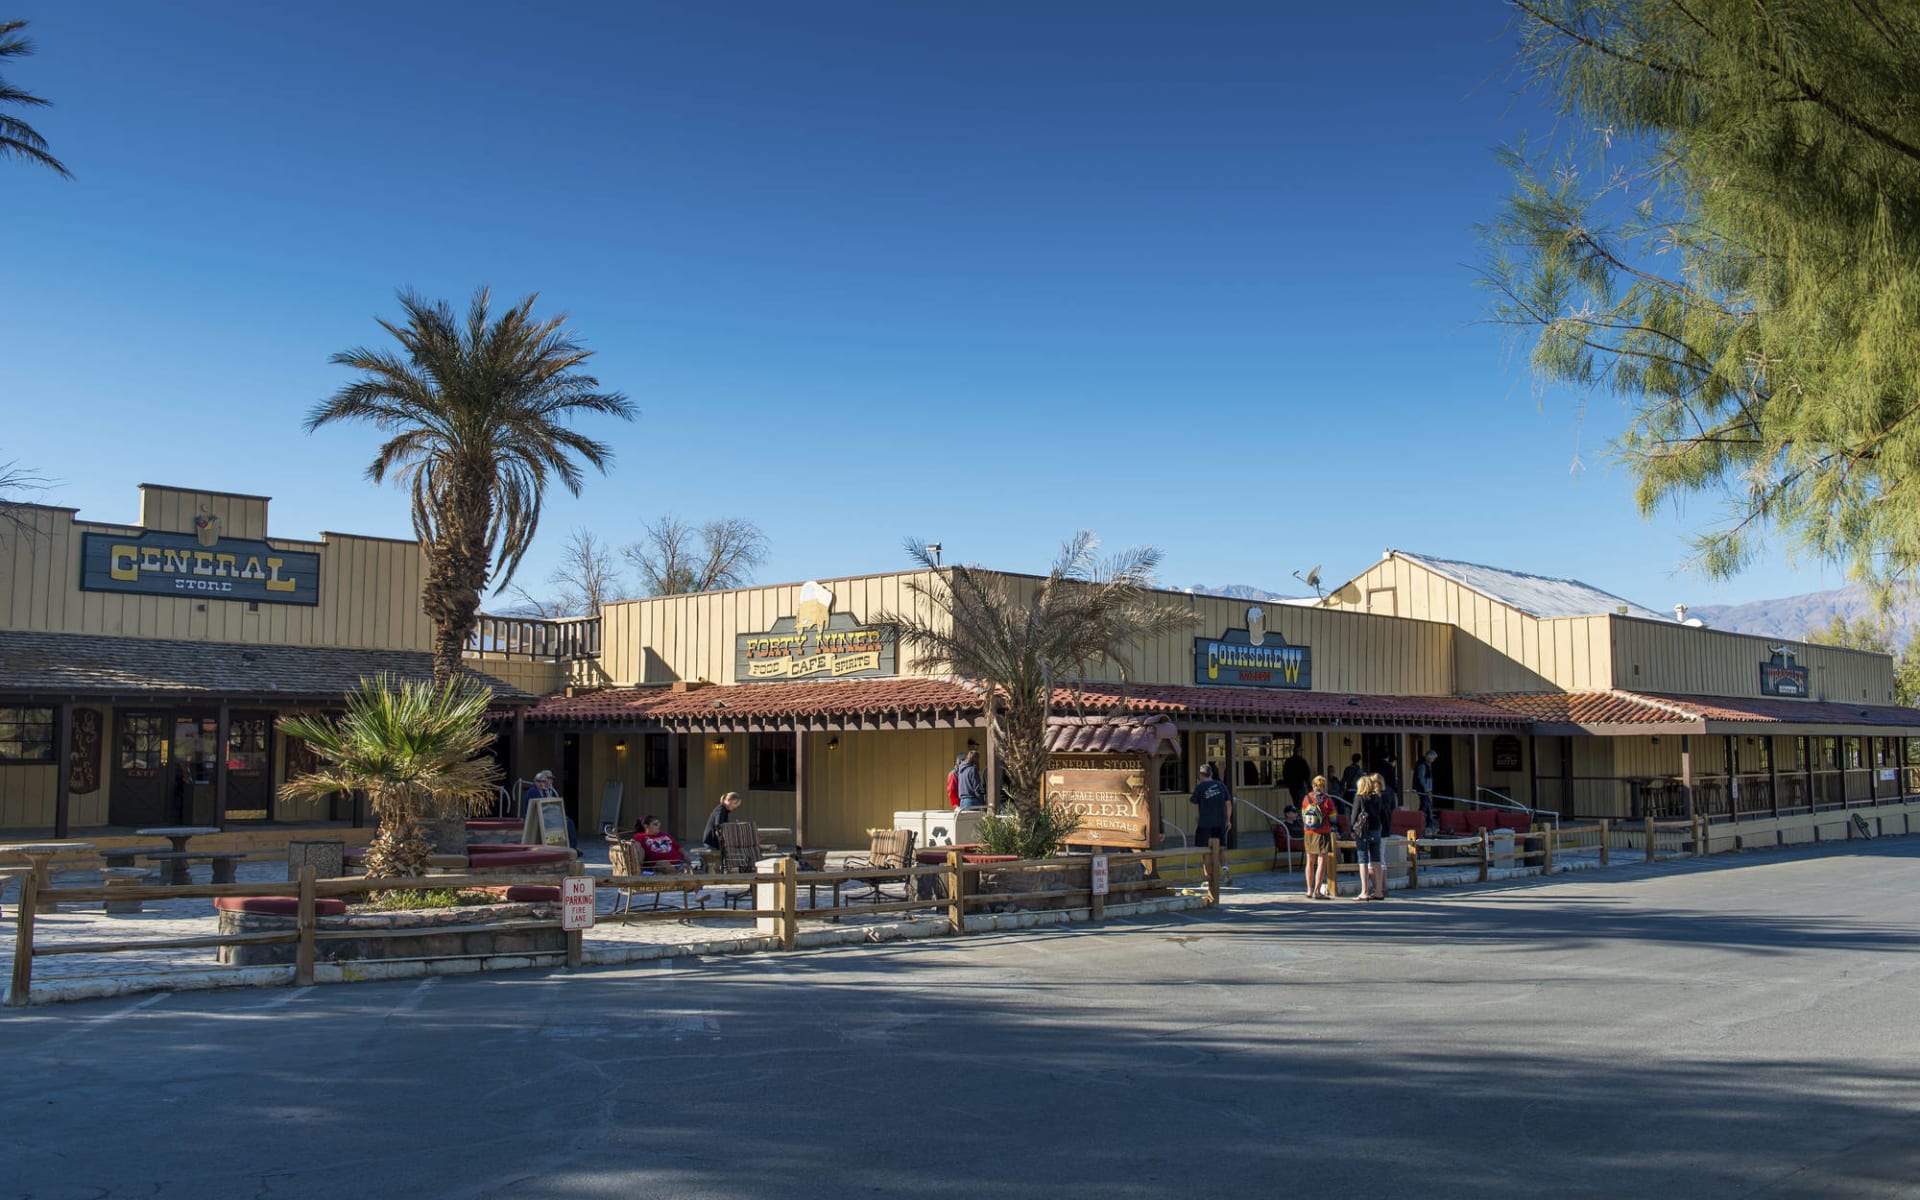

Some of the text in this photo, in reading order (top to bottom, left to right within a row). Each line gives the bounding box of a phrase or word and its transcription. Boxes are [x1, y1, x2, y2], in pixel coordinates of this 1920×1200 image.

[111, 545, 296, 592] GENERAL
[175, 579, 232, 591] STORE
[746, 630, 883, 657] FORTY NINER
[753, 662, 780, 674] FOOD
[791, 656, 826, 675] CAFE
[835, 655, 871, 672] SPIRITS
[1208, 642, 1302, 684] CORKSCREW
[1048, 760, 1144, 771] GENERAL STORE
[1096, 819, 1138, 831] RENTALS
[573, 883, 585, 893] NO
[565, 895, 592, 905] PARKING
[571, 906, 586, 914] FIRE
